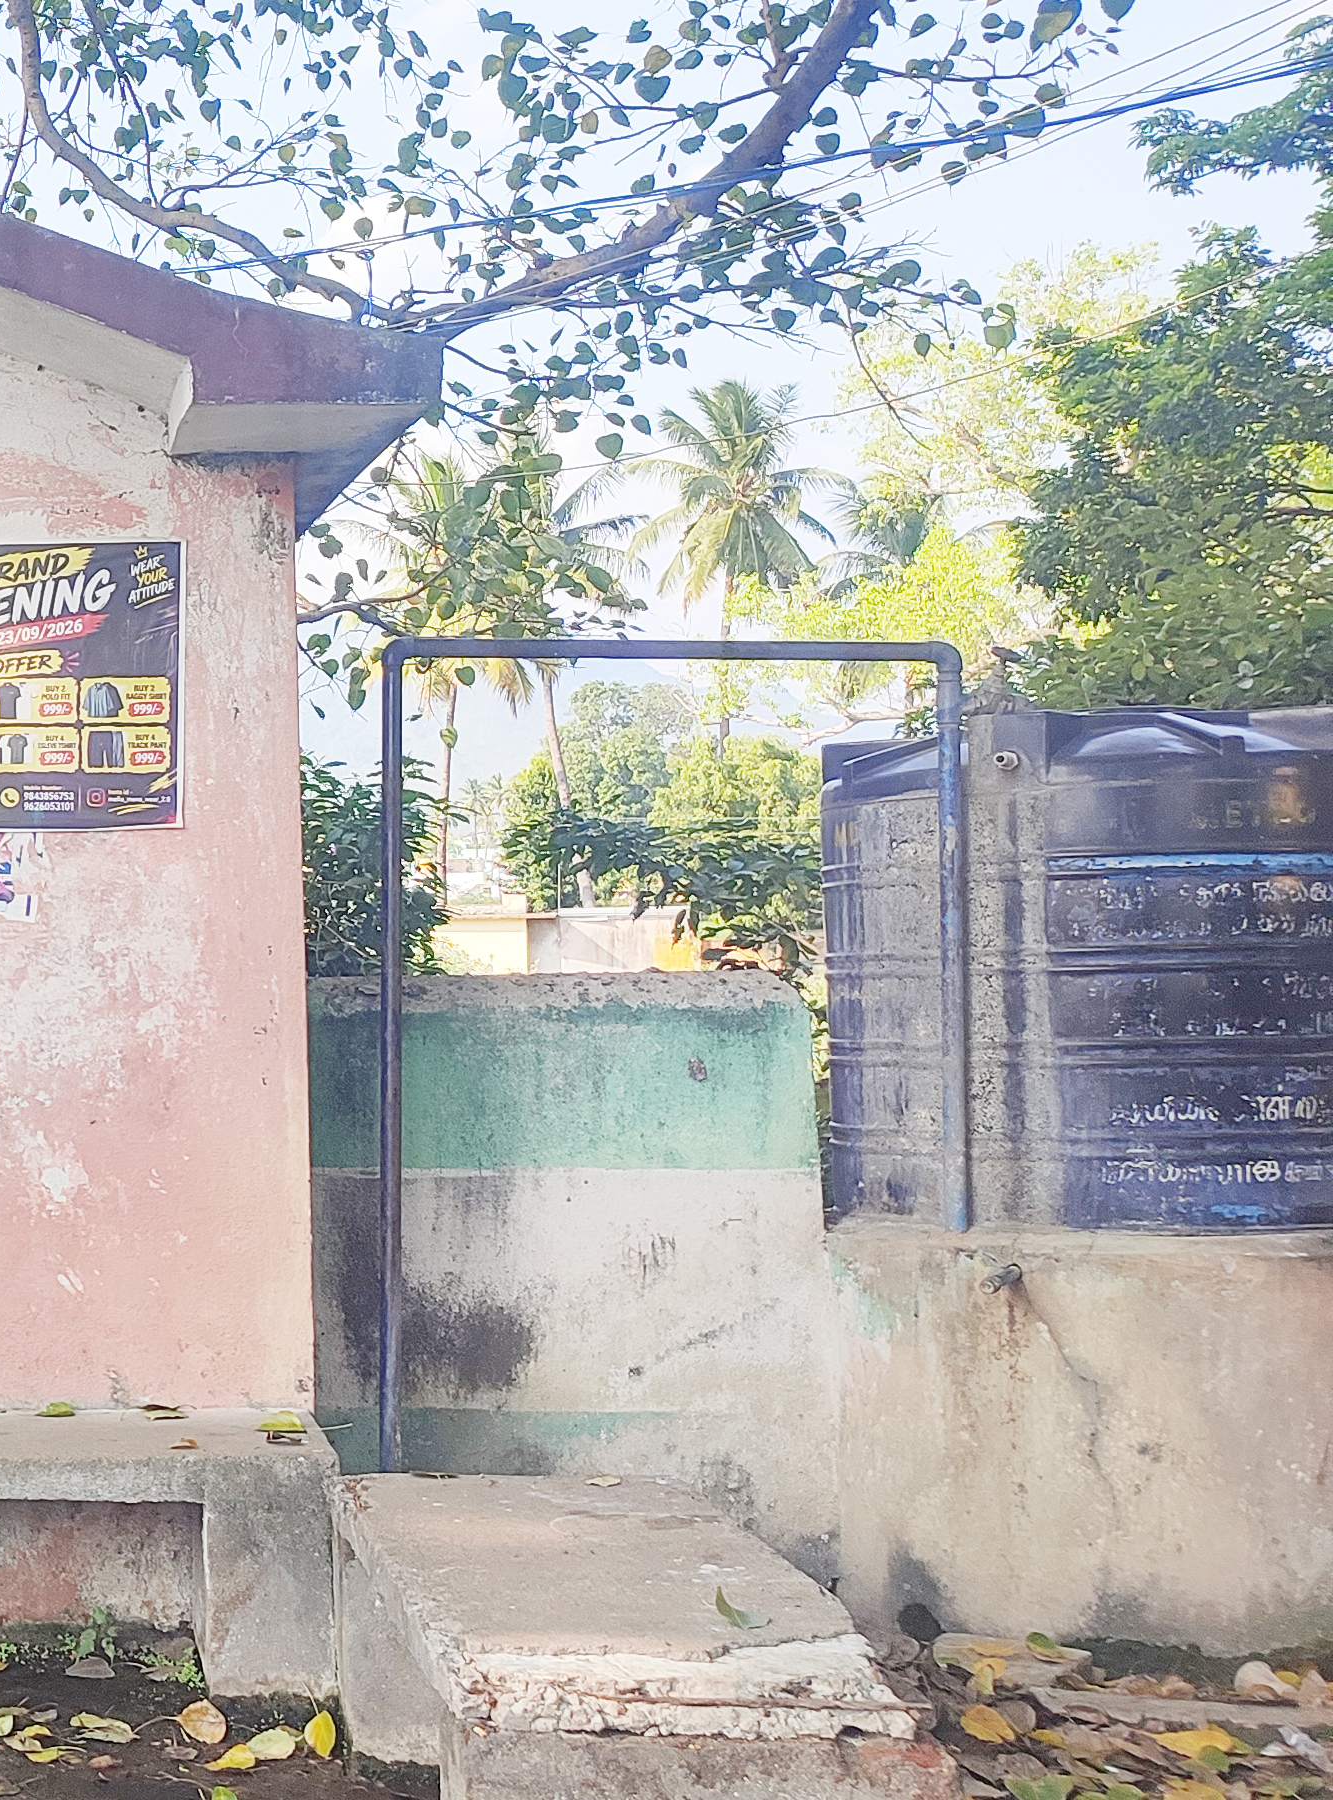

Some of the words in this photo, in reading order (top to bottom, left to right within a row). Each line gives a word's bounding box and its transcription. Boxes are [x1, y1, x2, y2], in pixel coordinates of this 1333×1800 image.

[130, 555, 164, 578] WEAR
[136, 567, 168, 587] YOUR
[127, 577, 176, 604] ATTITUDE
[43, 704, 70, 715] 999/-
[133, 703, 161, 715] 999/-
[44, 752, 72, 764] 999/-
[134, 752, 163, 764] 999/-
